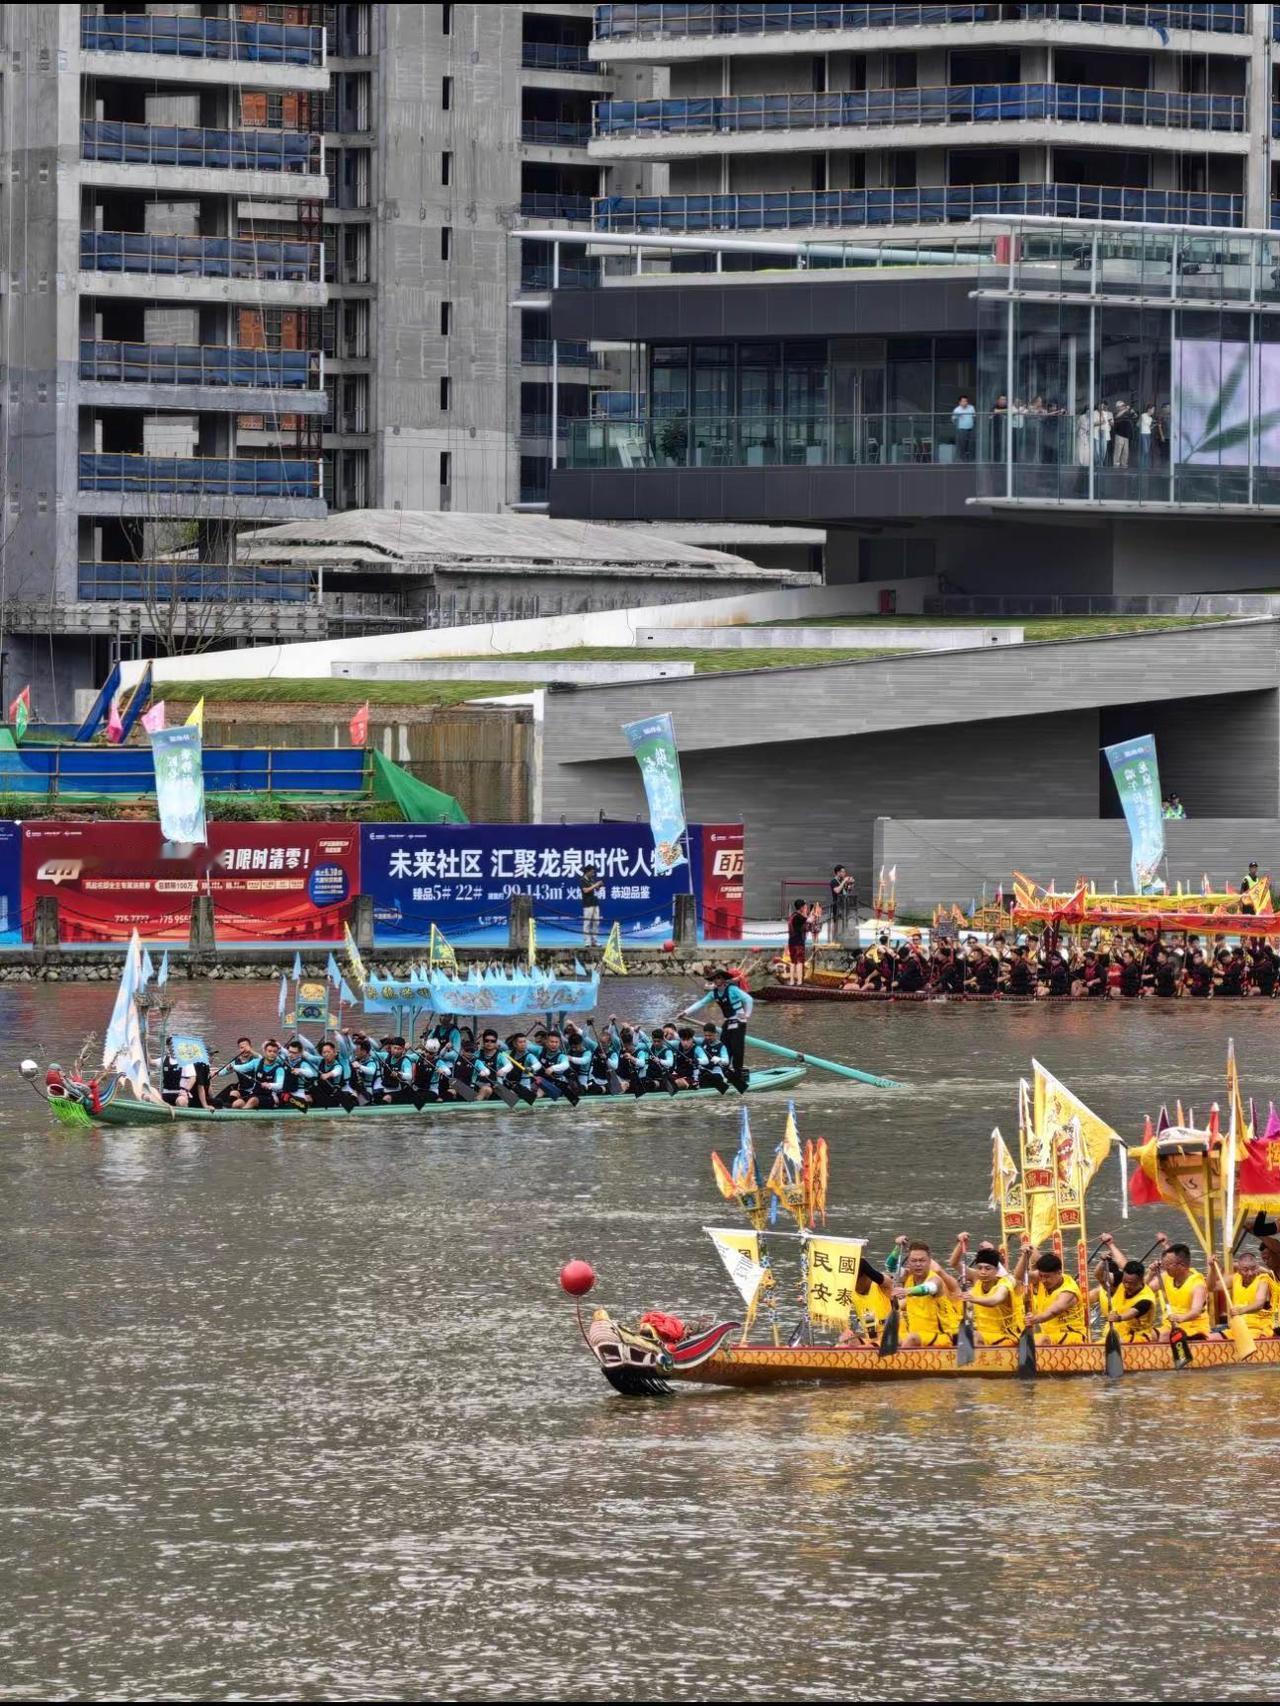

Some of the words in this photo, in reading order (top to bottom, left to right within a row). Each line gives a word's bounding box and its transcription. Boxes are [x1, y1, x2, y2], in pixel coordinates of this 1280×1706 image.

[388, 848, 483, 878] 未来社区
[455, 884, 483, 901] 22#
[611, 885, 650, 899] 恭迎品鉴
[810, 1251, 833, 1303] 民安
[835, 1255, 857, 1307] 國泰
